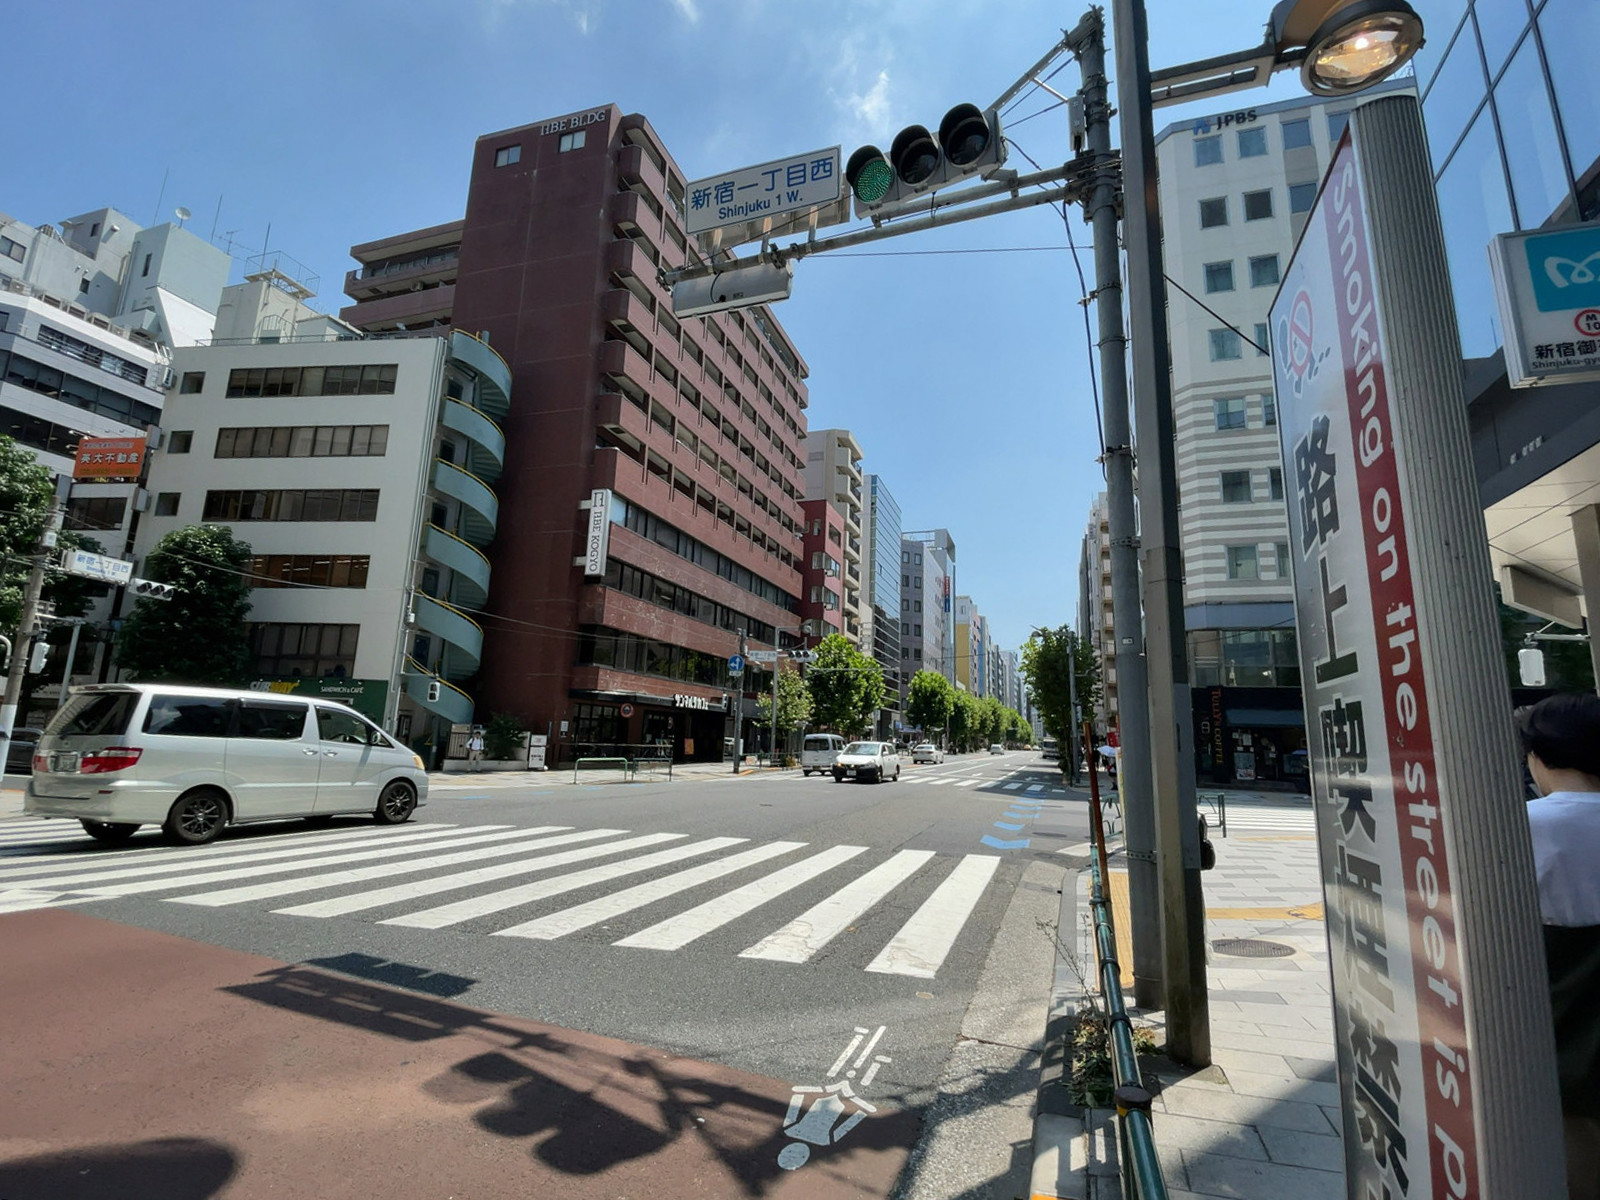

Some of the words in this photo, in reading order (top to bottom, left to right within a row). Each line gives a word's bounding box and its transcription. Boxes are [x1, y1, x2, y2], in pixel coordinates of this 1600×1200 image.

[570, 110, 606, 129] BLDG
[1216, 109, 1257, 130] JPBS
[690, 156, 833, 211] 新宿一丁目西
[718, 197, 771, 220] Shinjuku
[775, 193, 782, 206] 1
[786, 189, 803, 204] W.
[1585, 313, 1597, 321] M
[1533, 339, 1600, 360] 新宿御
[588, 534, 601, 572] KOGYO
[1293, 414, 1410, 1200] 路上喫煙禁
[1372, 486, 1398, 582] on
[1386, 601, 1418, 732] the
[1403, 760, 1458, 1009] street
[1433, 1037, 1467, 1109] is
